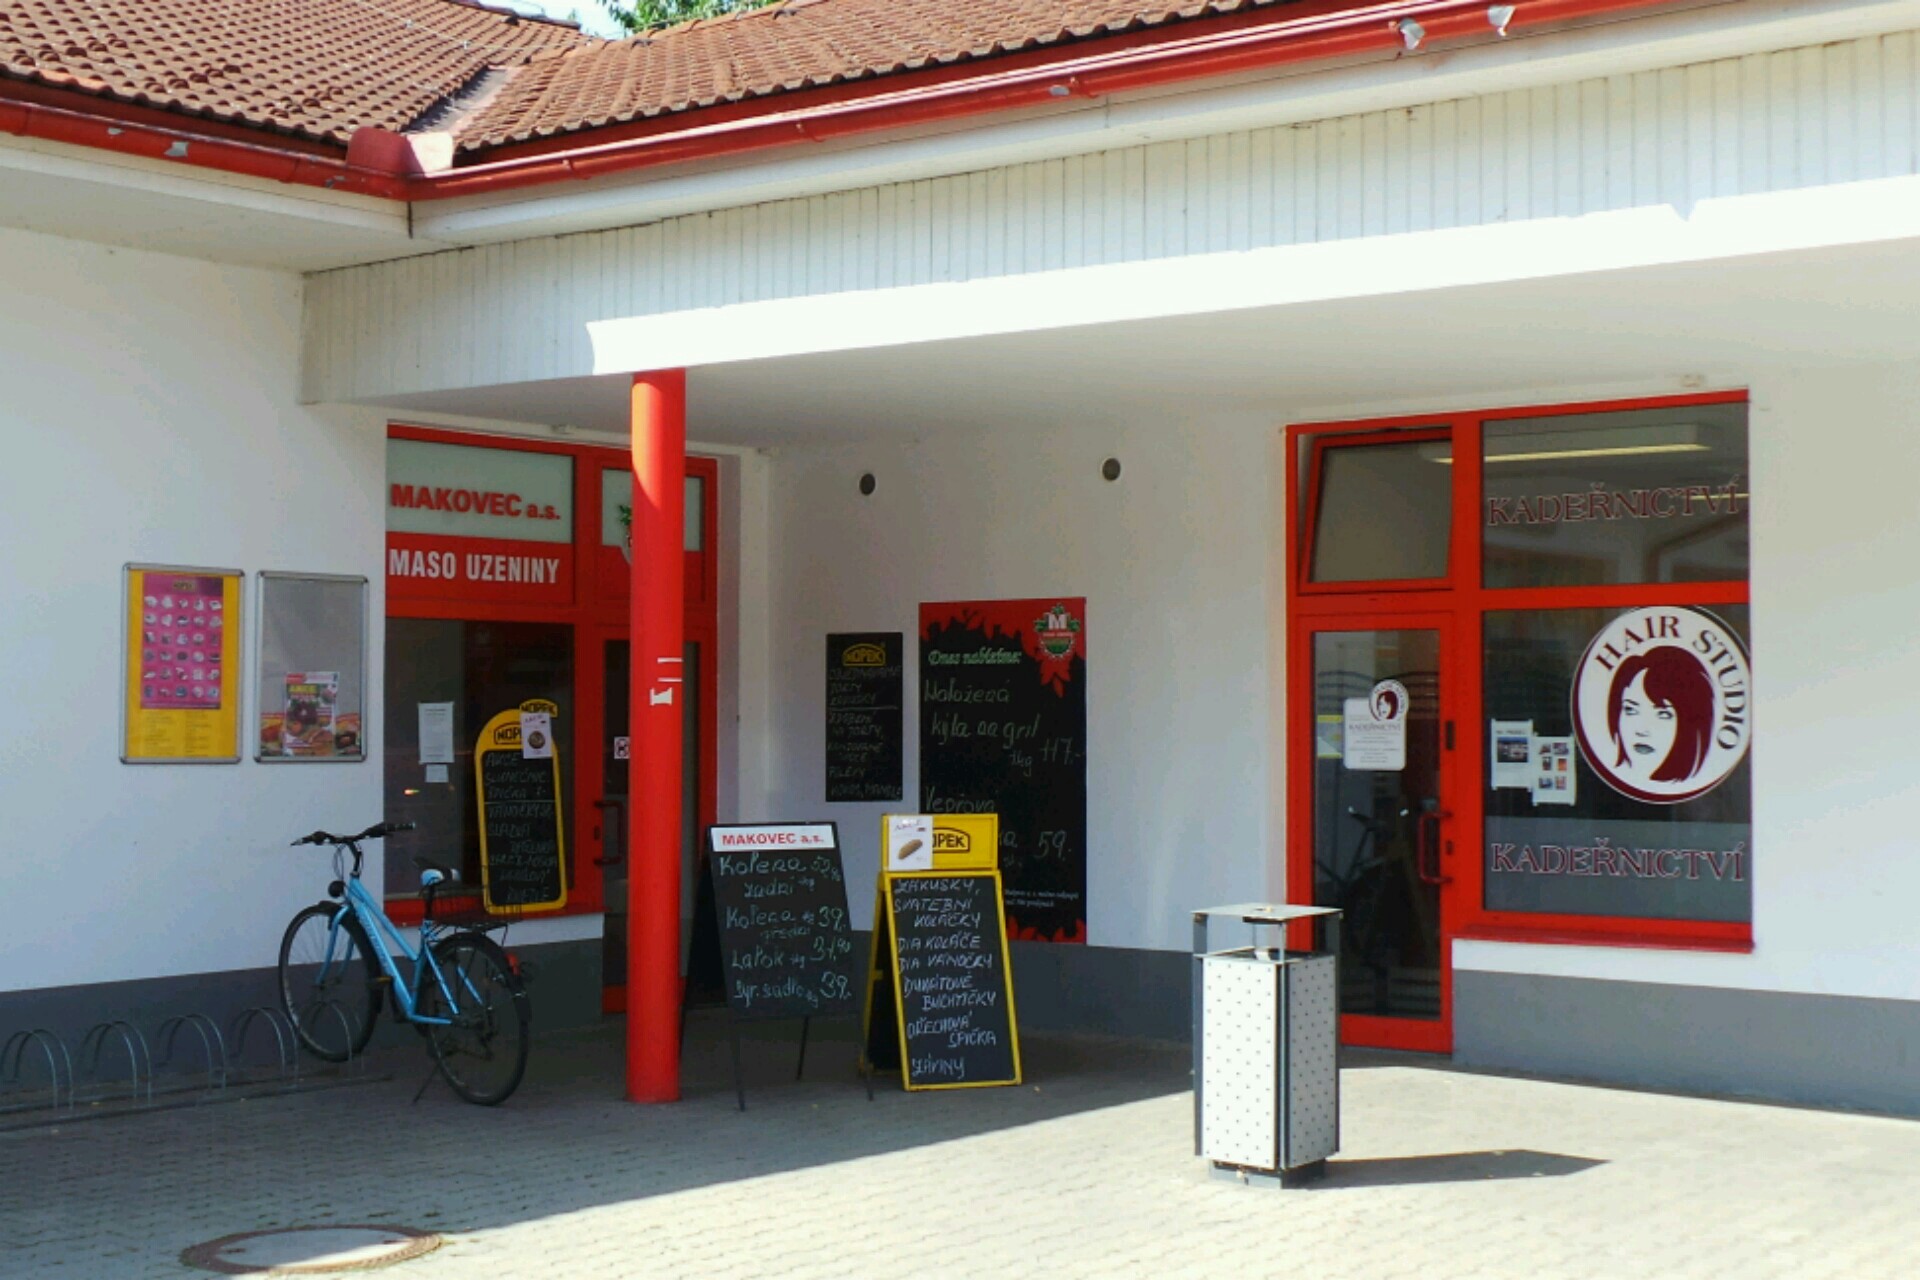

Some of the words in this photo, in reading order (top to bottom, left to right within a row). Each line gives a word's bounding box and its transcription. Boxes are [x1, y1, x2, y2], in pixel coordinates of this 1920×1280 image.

[391, 483, 523, 517] MAKOVEC
[526, 503, 561, 520] a.s.
[1486, 474, 1741, 526] KADEŘNICTVÍ
[388, 549, 456, 579] MASO
[466, 554, 560, 584] UZENINY
[1595, 615, 1681, 671] HAIR
[1692, 629, 1746, 750] STUDIO
[721, 832, 796, 846] MAKOVEC
[800, 835, 825, 844] a.s.
[1491, 837, 1744, 881] KADEŘNICTVÍ
[898, 936, 921, 953] DIA
